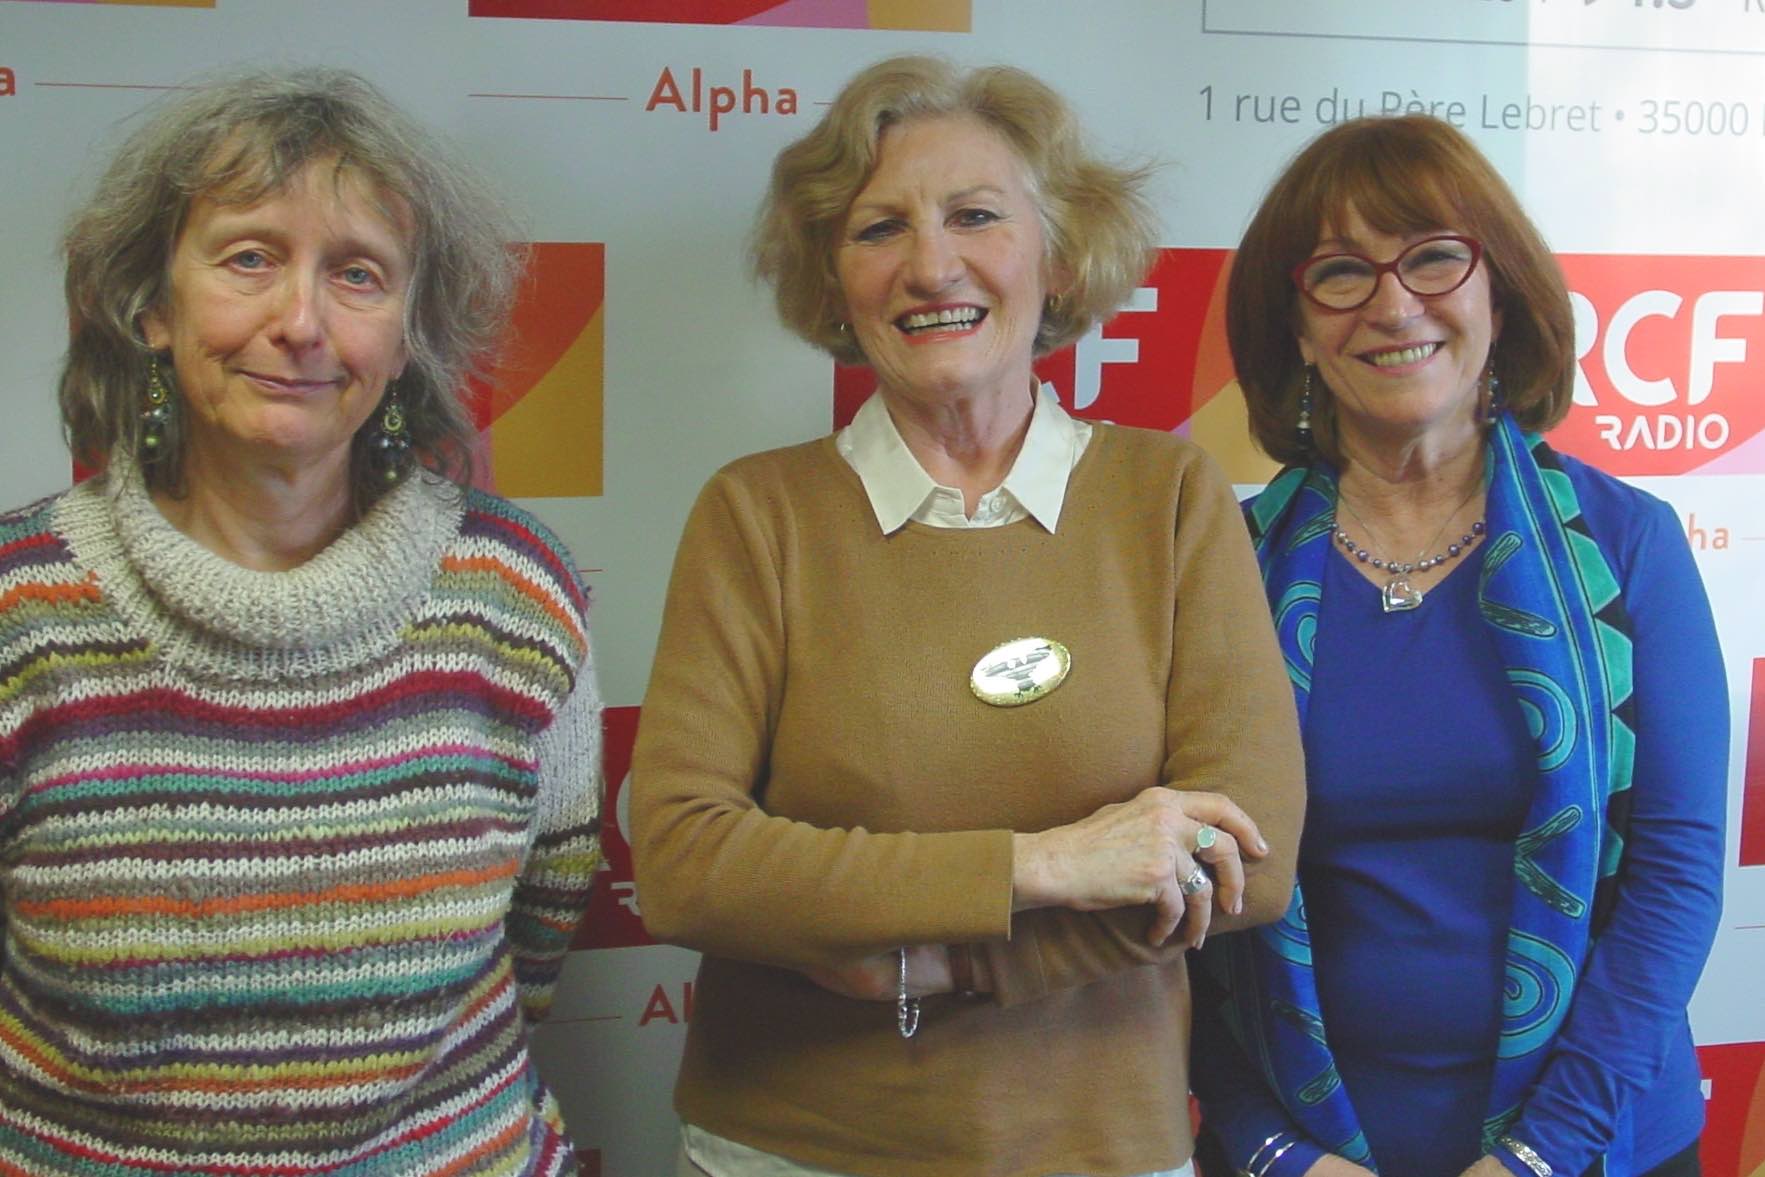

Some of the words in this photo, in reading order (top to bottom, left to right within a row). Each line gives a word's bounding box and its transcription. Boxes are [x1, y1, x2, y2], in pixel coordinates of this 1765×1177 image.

[645, 66, 798, 132] Alpha
[1199, 85, 1212, 121] 1
[1234, 93, 1301, 124] rue
[1315, 87, 1364, 125] du
[1381, 89, 1466, 128] Père
[1481, 94, 1601, 132] Lebret
[1638, 99, 1748, 137] 35000
[1595, 413, 1729, 450] RADIO
